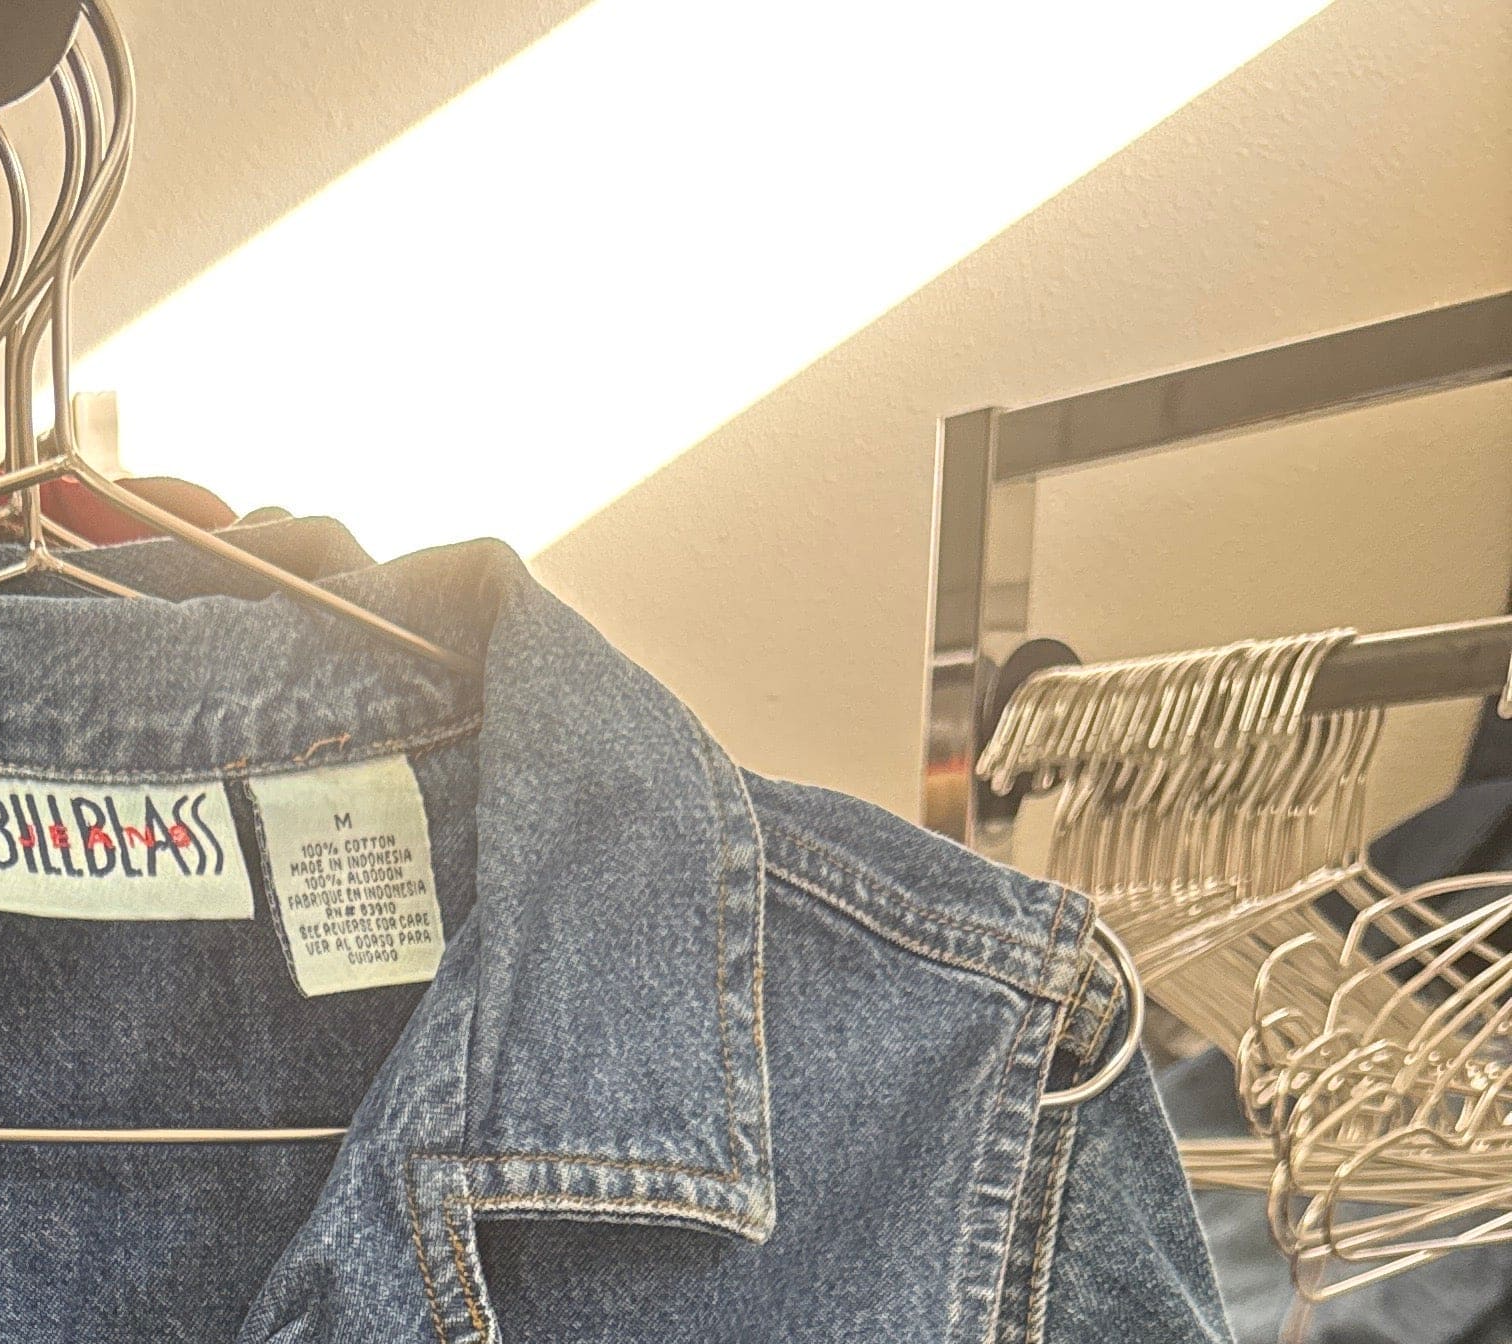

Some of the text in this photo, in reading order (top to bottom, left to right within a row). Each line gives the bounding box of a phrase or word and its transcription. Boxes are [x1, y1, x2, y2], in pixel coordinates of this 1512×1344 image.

[334, 813, 353, 831] M
[19, 824, 192, 849] JEANS
[301, 834, 396, 859] 100% COTTON
[290, 848, 413, 877] MADE IN INDONESIA
[304, 874, 342, 890] 100%
[346, 888, 362, 902] EN
[363, 879, 427, 900] INDONESIA
[325, 906, 342, 920] RN
[299, 912, 431, 940] SEE REVERSE FOR CARE
[305, 929, 433, 956] VER AL DORSO PARA
[347, 949, 399, 965] CUIDADO
